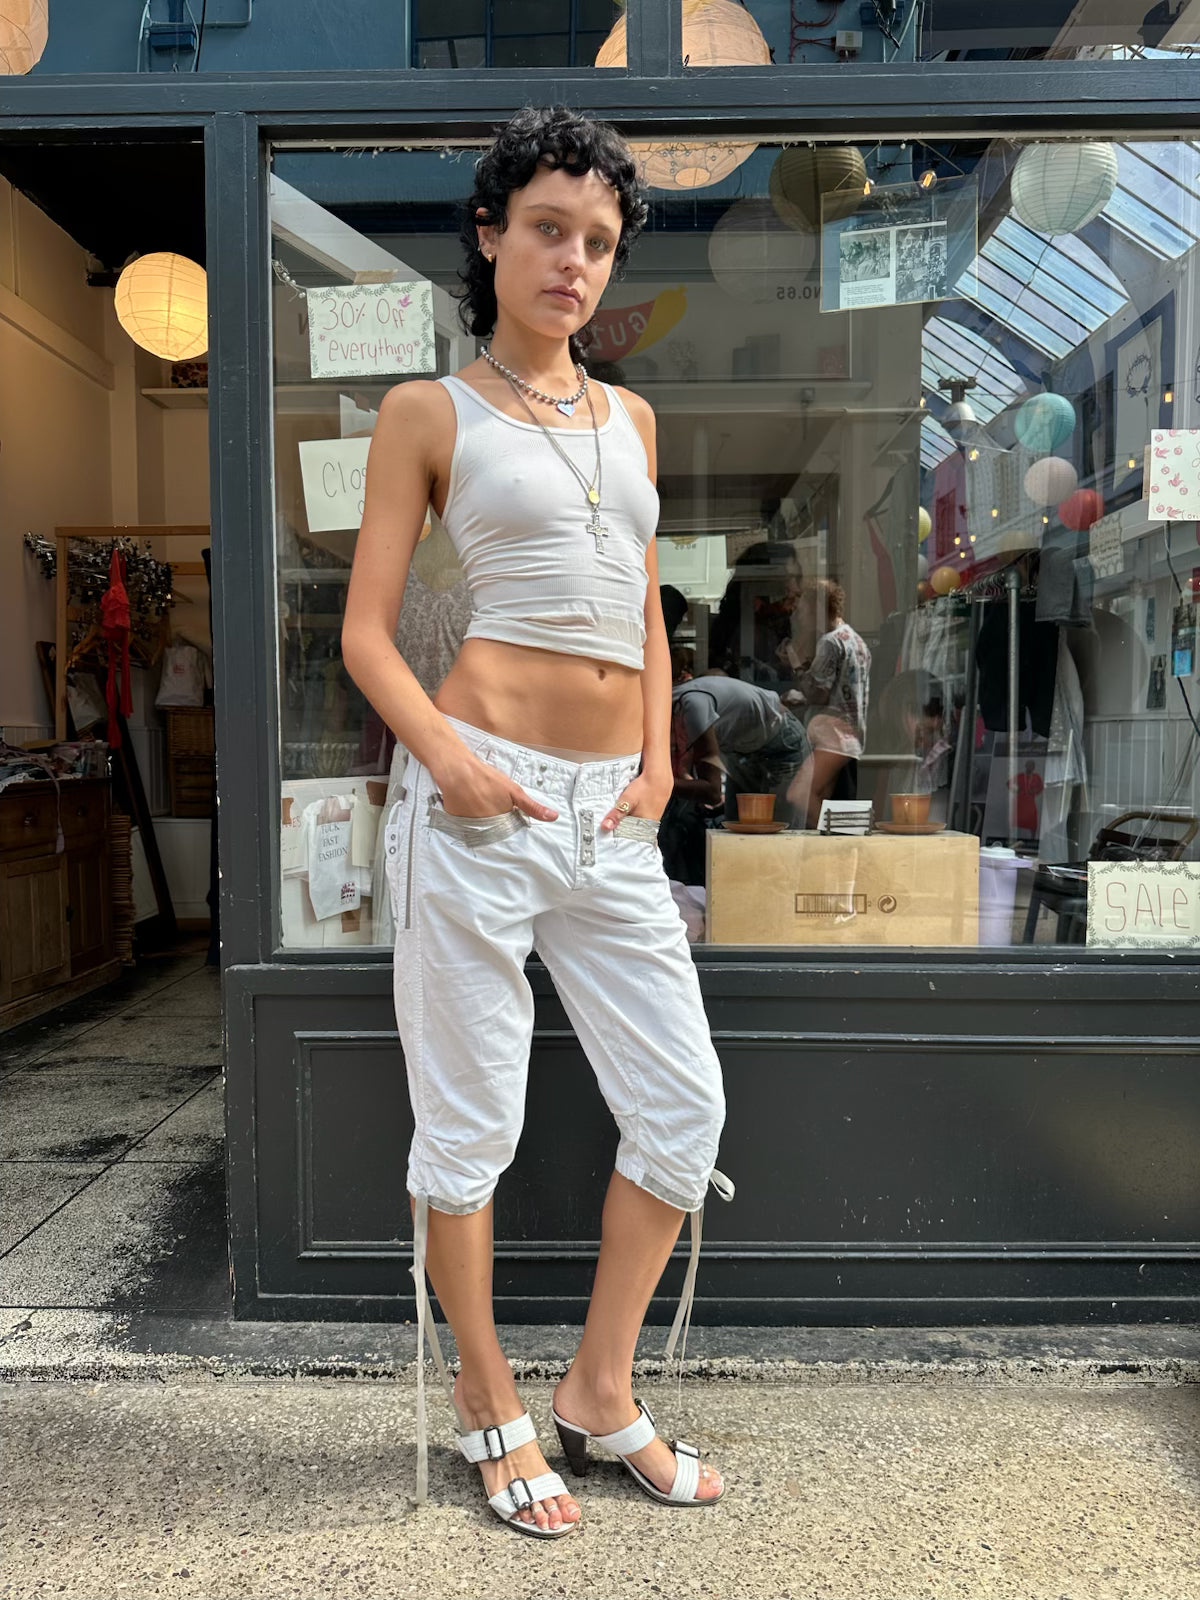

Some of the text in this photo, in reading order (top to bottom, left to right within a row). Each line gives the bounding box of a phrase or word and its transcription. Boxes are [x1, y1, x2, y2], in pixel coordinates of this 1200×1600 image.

[321, 297, 366, 331] 30%
[328, 337, 414, 368] everything
[322, 836, 340, 847] FAST
[318, 846, 348, 862] FASHION
